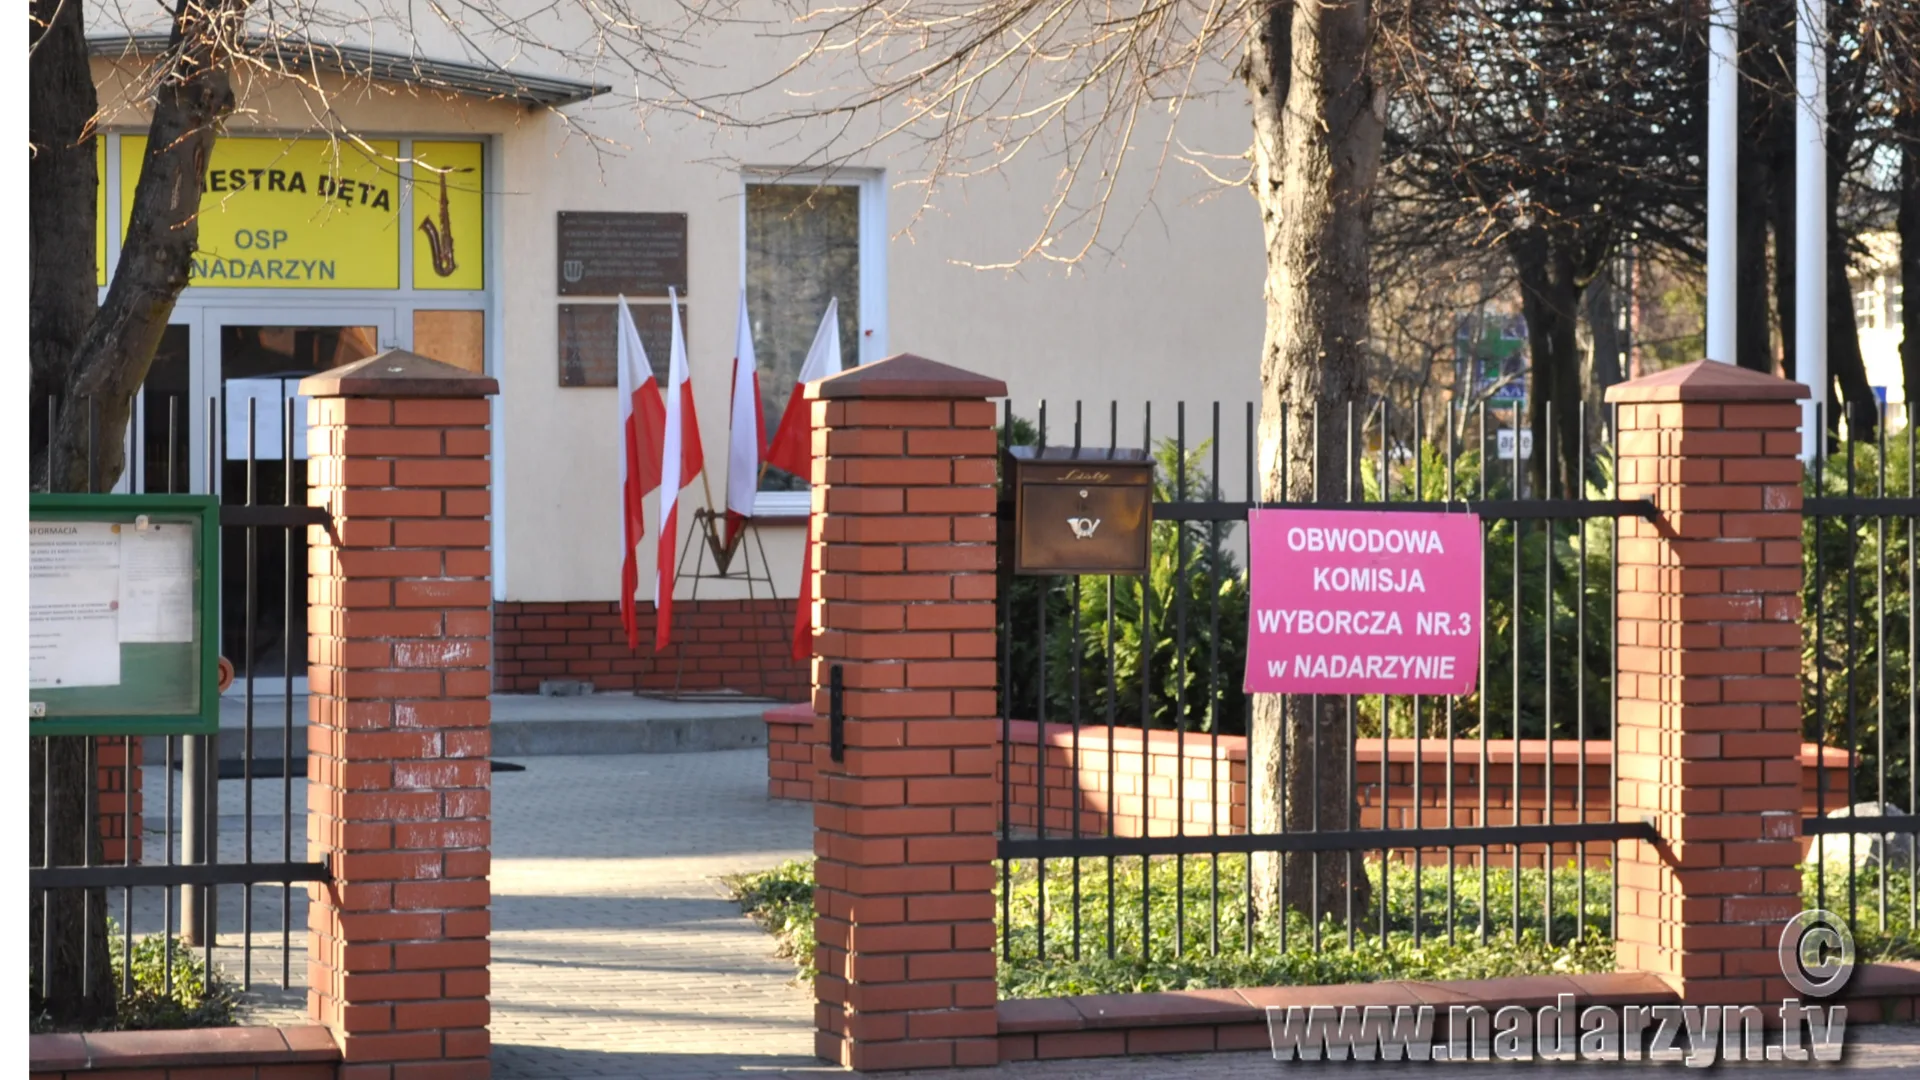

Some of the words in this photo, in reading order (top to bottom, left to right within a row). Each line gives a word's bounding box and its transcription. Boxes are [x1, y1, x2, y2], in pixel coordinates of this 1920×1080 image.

[318, 174, 391, 212] DĘTA
[234, 228, 288, 250] OSP
[192, 259, 336, 280] NADARZYN
[1056, 469, 1111, 481] Listy
[1287, 527, 1444, 554] OBWODOWA
[1313, 567, 1426, 593] KOMISJA
[1257, 609, 1403, 636] WYBORCZA
[1416, 612, 1472, 636] NR.3
[1267, 659, 1287, 678] w
[1293, 655, 1456, 680] NADARZYNIE
